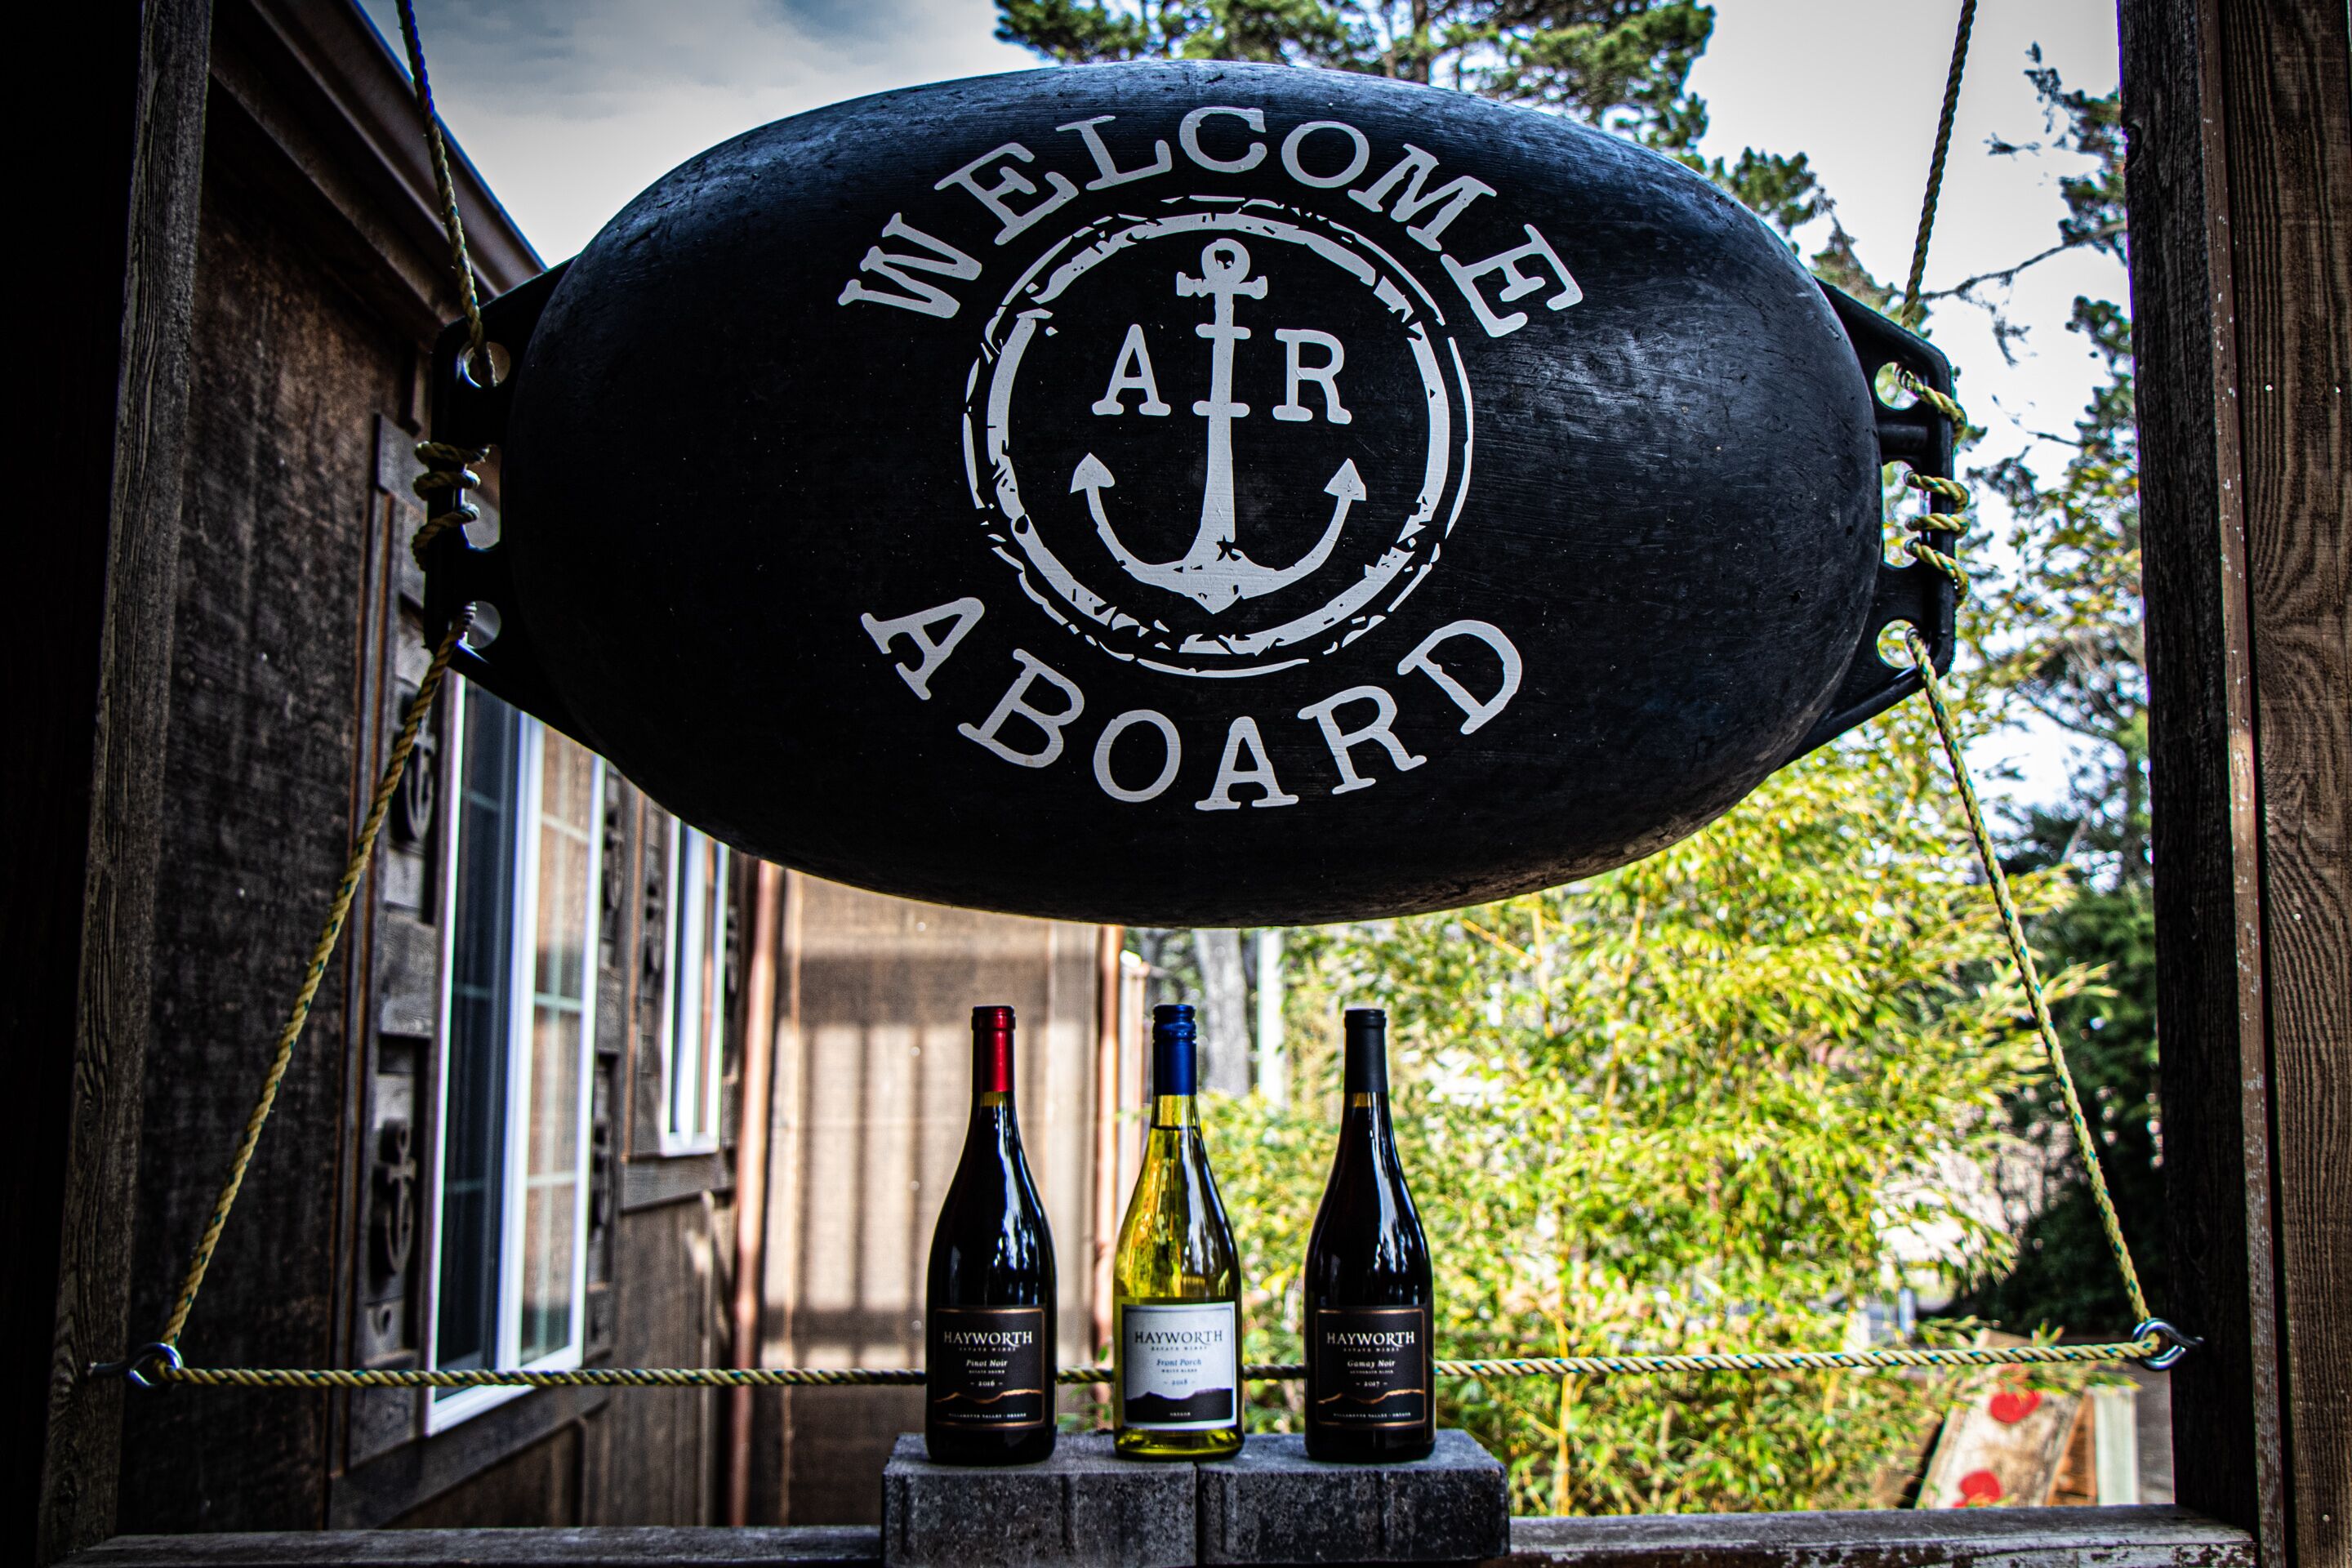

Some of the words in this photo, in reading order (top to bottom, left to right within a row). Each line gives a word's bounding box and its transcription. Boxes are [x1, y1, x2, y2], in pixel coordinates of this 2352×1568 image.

[838, 105, 1584, 338] WELCOME
[1091, 323, 1171, 416] A
[1272, 327, 1352, 425] R
[860, 596, 1523, 811] ABOARD
[943, 1331, 1033, 1348] HAYWORTH
[1134, 1330, 1223, 1346] HAYWORTH
[1326, 1331, 1415, 1348] HAYWORTH
[966, 1359, 987, 1367] Pinot
[989, 1359, 1008, 1367] Noir
[1156, 1358, 1178, 1366] Front
[1179, 1358, 1202, 1366] Porch
[1347, 1360, 1375, 1369] Gamay
[1377, 1359, 1396, 1367] Noir
[1364, 1380, 1380, 1388] 2017
